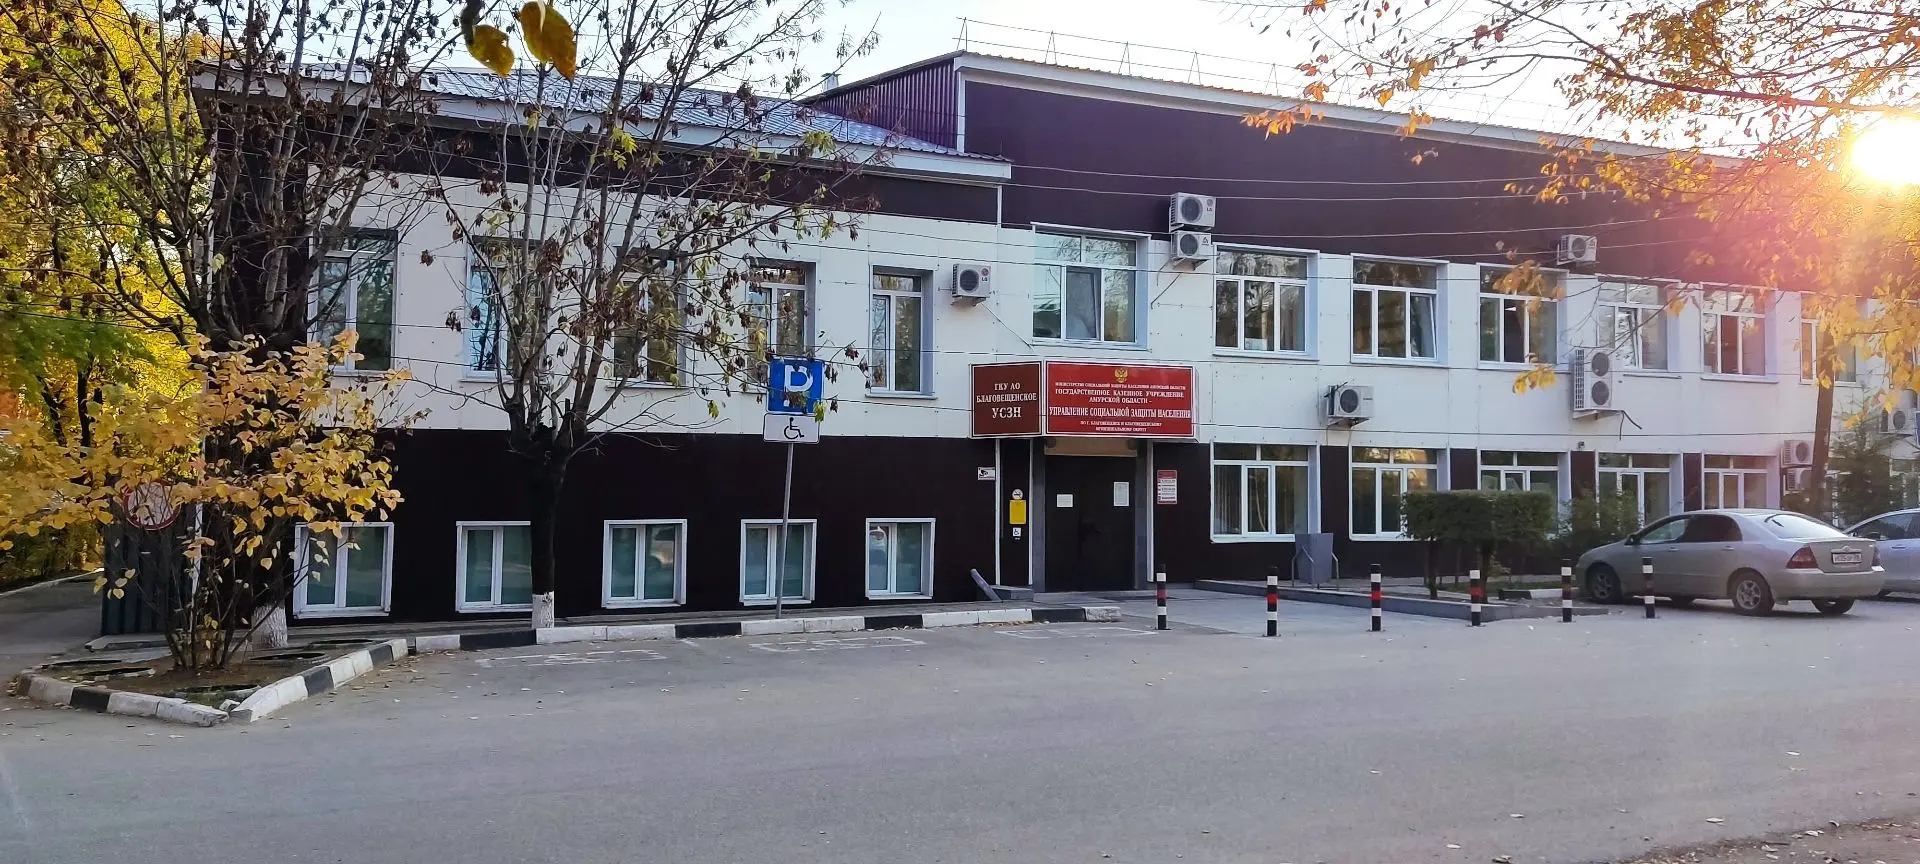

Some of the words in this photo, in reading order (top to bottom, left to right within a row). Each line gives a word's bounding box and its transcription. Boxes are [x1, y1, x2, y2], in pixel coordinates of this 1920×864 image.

[784, 364, 814, 407] P
[994, 383, 1009, 391] ГКУ
[1010, 382, 1021, 390] АО
[1055, 388, 1111, 396] ГОСУДАРСТВЕННОЕ
[976, 393, 1038, 403] БЛАГОВЕЩЕНСКОЕ
[992, 406, 1022, 419] УСЗН
[1049, 406, 1089, 416] УПРАВЛЕНИЕ
[1090, 407, 1129, 417] СОЦИАЛЬНОЙ
[1131, 408, 1156, 418] ЗАЩИТЫ
